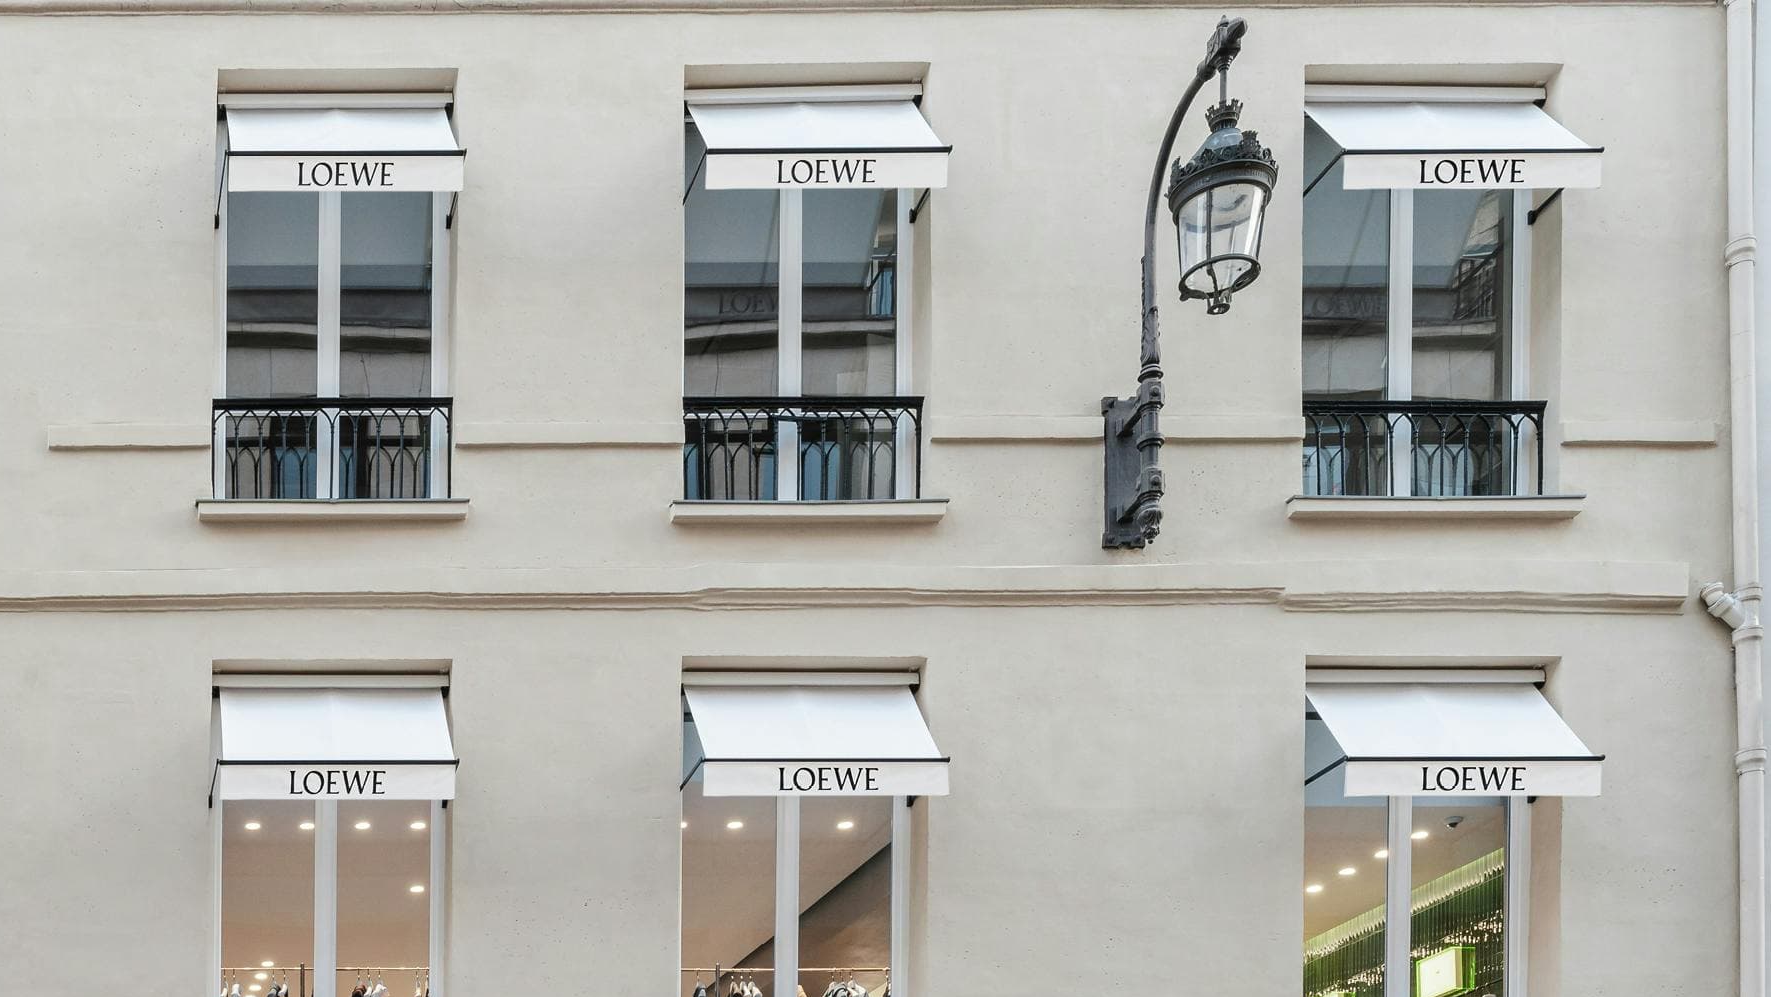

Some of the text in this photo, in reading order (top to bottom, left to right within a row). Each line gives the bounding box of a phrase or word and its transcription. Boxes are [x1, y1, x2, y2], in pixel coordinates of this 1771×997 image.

[298, 162, 395, 187] LOEWE
[777, 159, 877, 184] LOEWE
[1419, 159, 1526, 184] LOEWE
[289, 770, 386, 795] LOEWE
[778, 767, 879, 792] LOEWE
[1422, 766, 1527, 792] LOEWE
